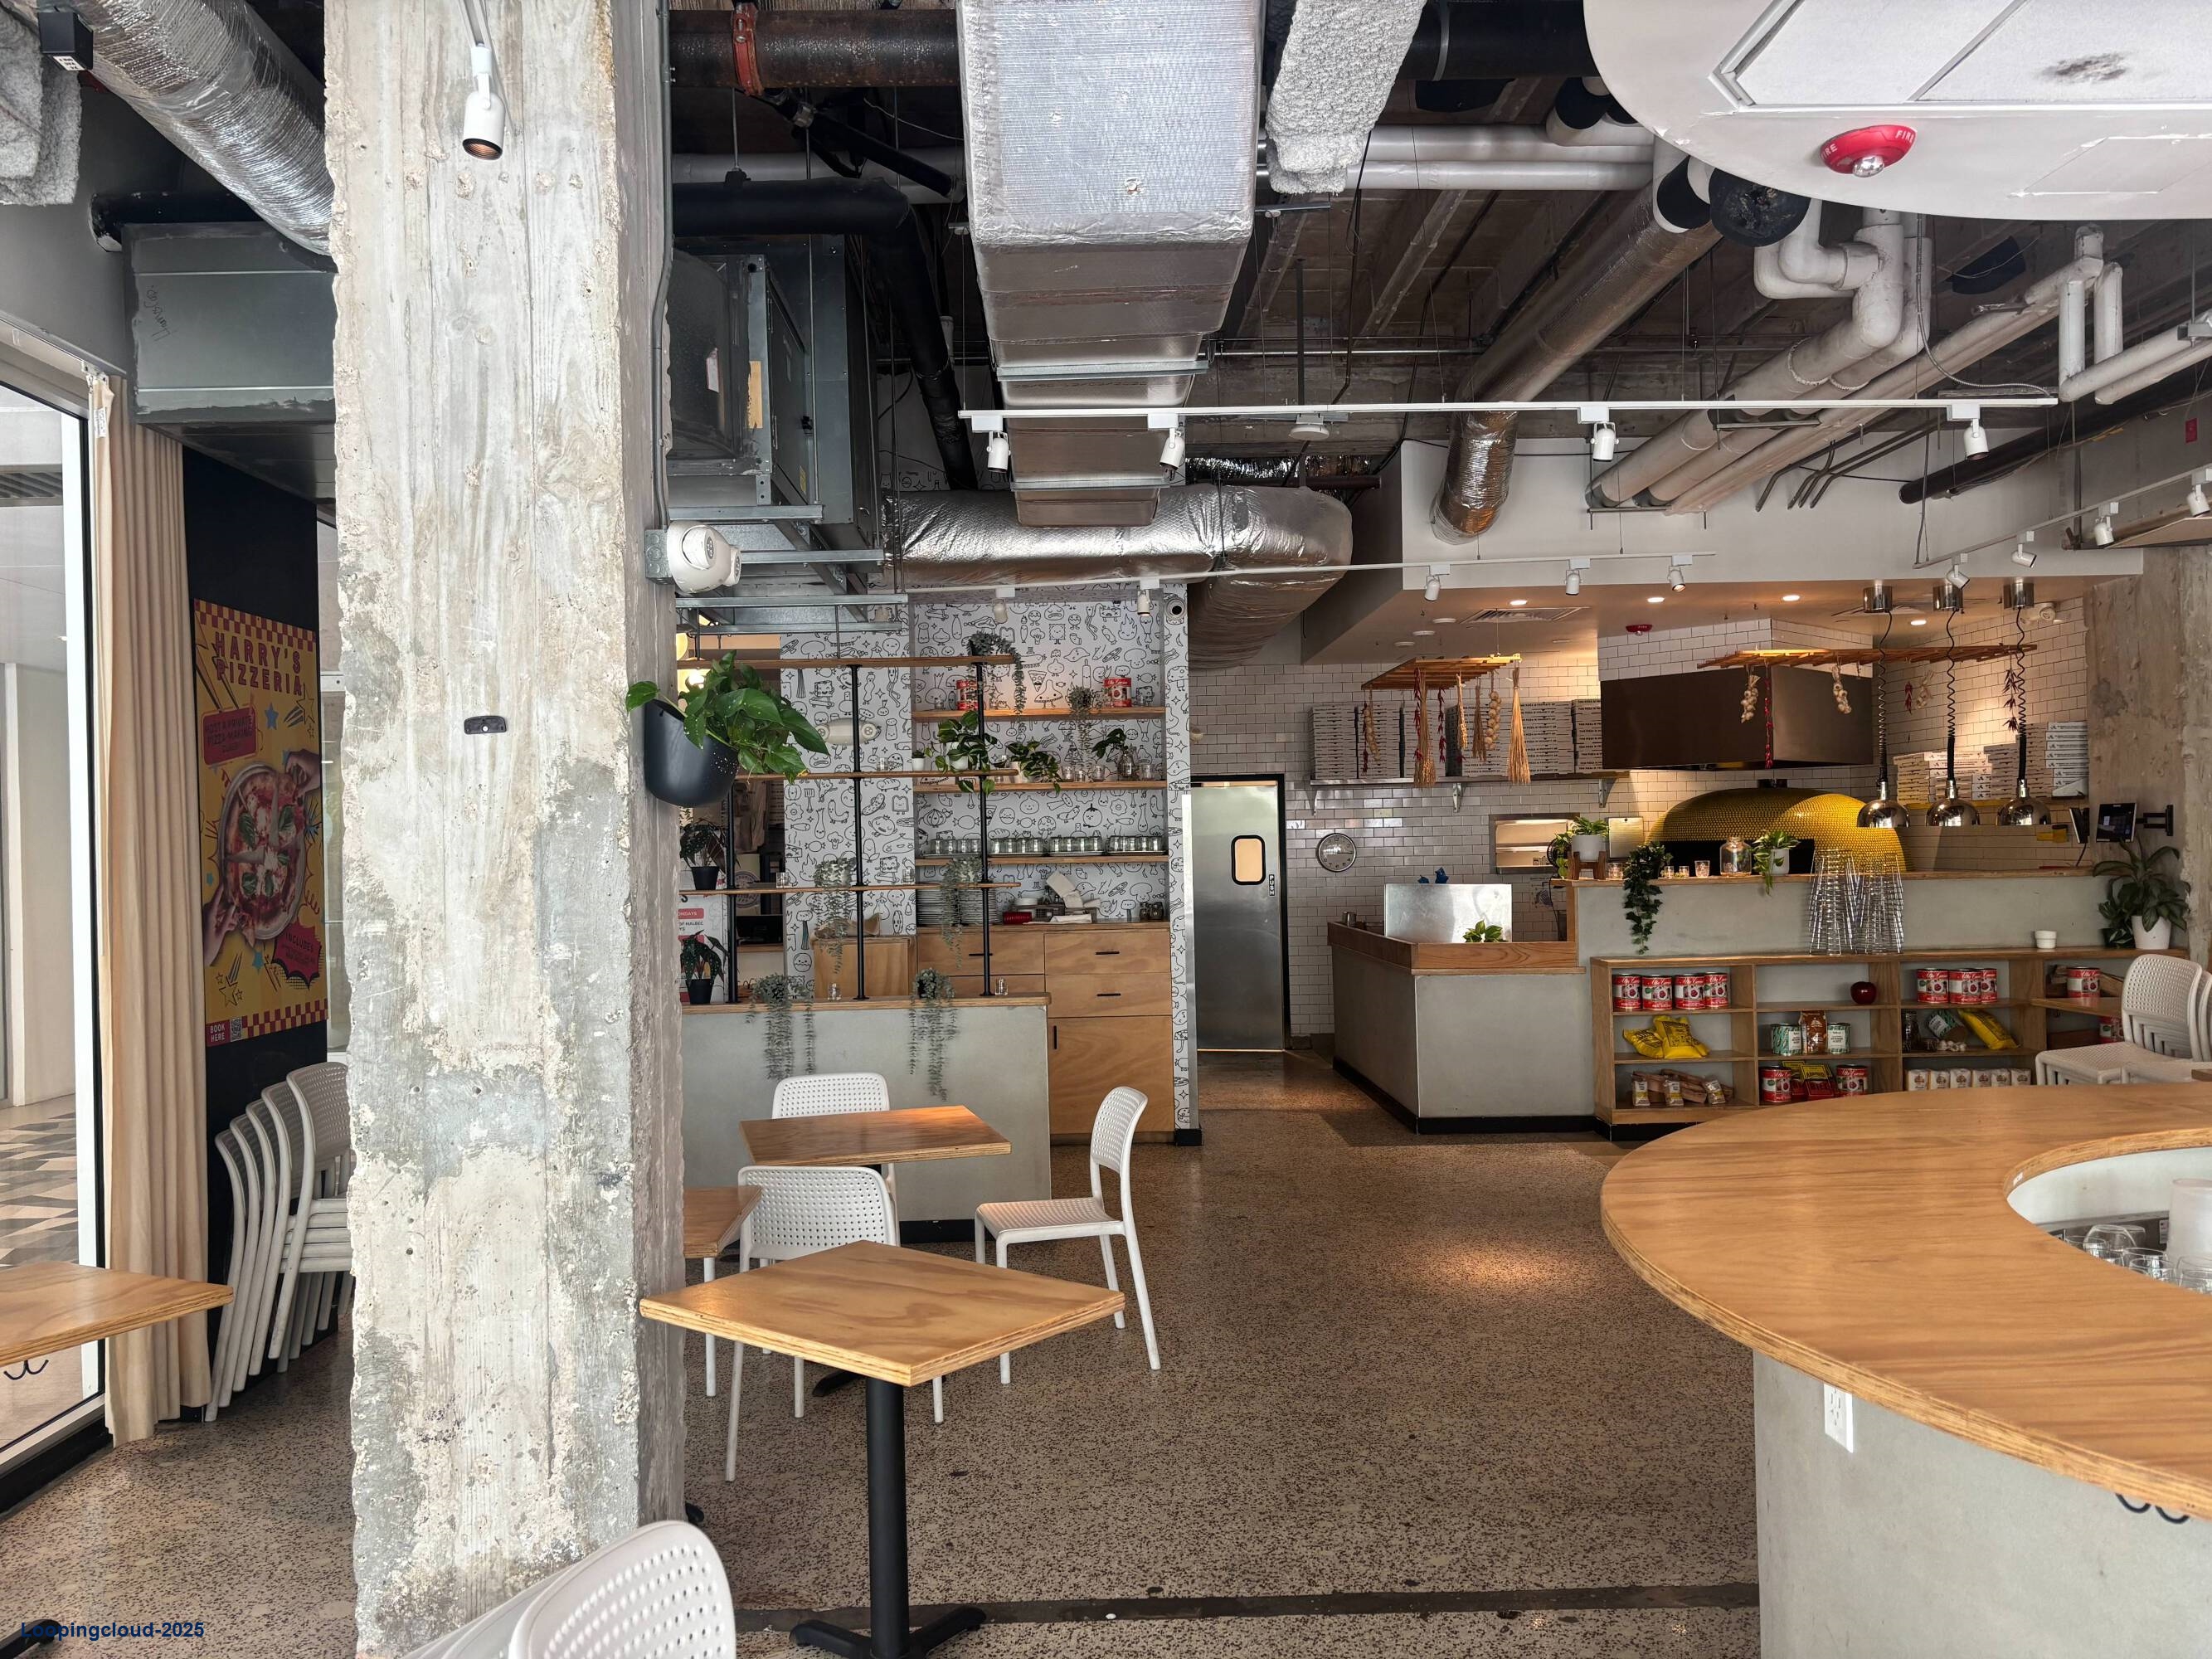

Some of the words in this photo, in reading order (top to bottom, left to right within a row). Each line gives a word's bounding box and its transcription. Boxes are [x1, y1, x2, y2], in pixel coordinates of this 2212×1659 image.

[1895, 130, 1914, 144] FIRE
[215, 631, 301, 674] HARRY'S
[216, 658, 302, 696] PIZZERIA
[210, 1022, 226, 1034] BOOK
[211, 1032, 226, 1043] HERE
